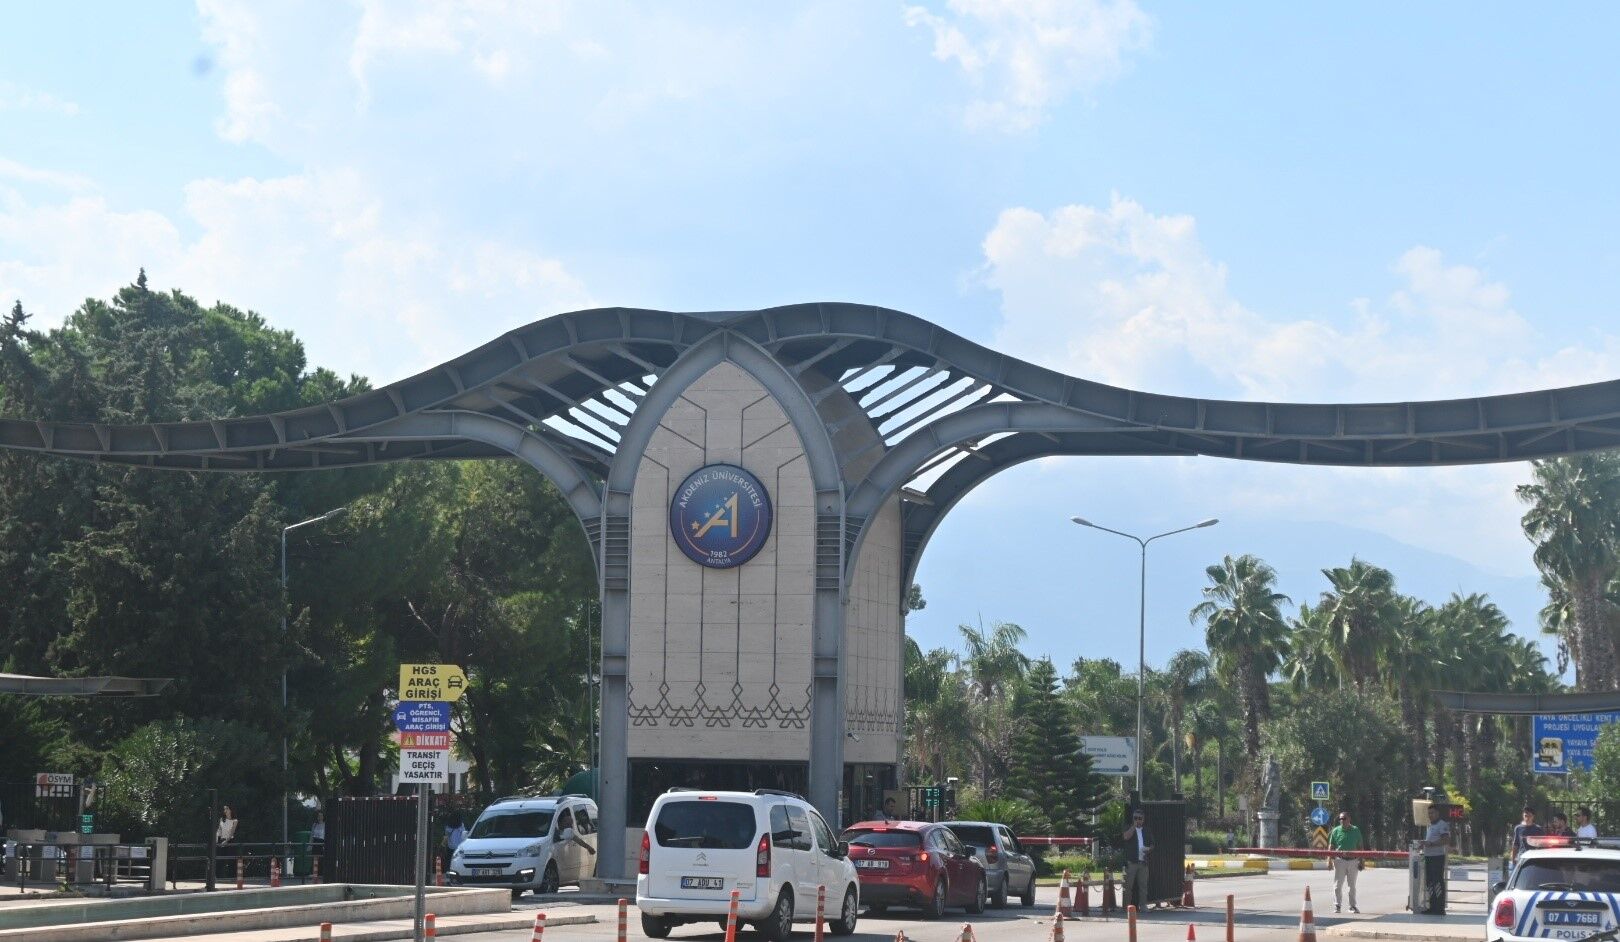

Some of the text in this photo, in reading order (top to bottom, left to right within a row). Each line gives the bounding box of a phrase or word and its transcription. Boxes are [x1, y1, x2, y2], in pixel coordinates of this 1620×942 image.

[680, 471, 763, 508] AKDENİZ ÜNİVERSİTESİ
[710, 550, 727, 558] 1982
[412, 666, 437, 675] HGS
[408, 678, 440, 688] ARAÇ
[405, 688, 442, 700] GİRİŞİ
[416, 734, 447, 746] DİKKAT!
[407, 750, 441, 759] TRANSİT
[48, 774, 71, 783] ÖSYM
[404, 771, 442, 779] YASAKTIR
[1548, 912, 1559, 922] 07
[1564, 913, 1569, 923] A
